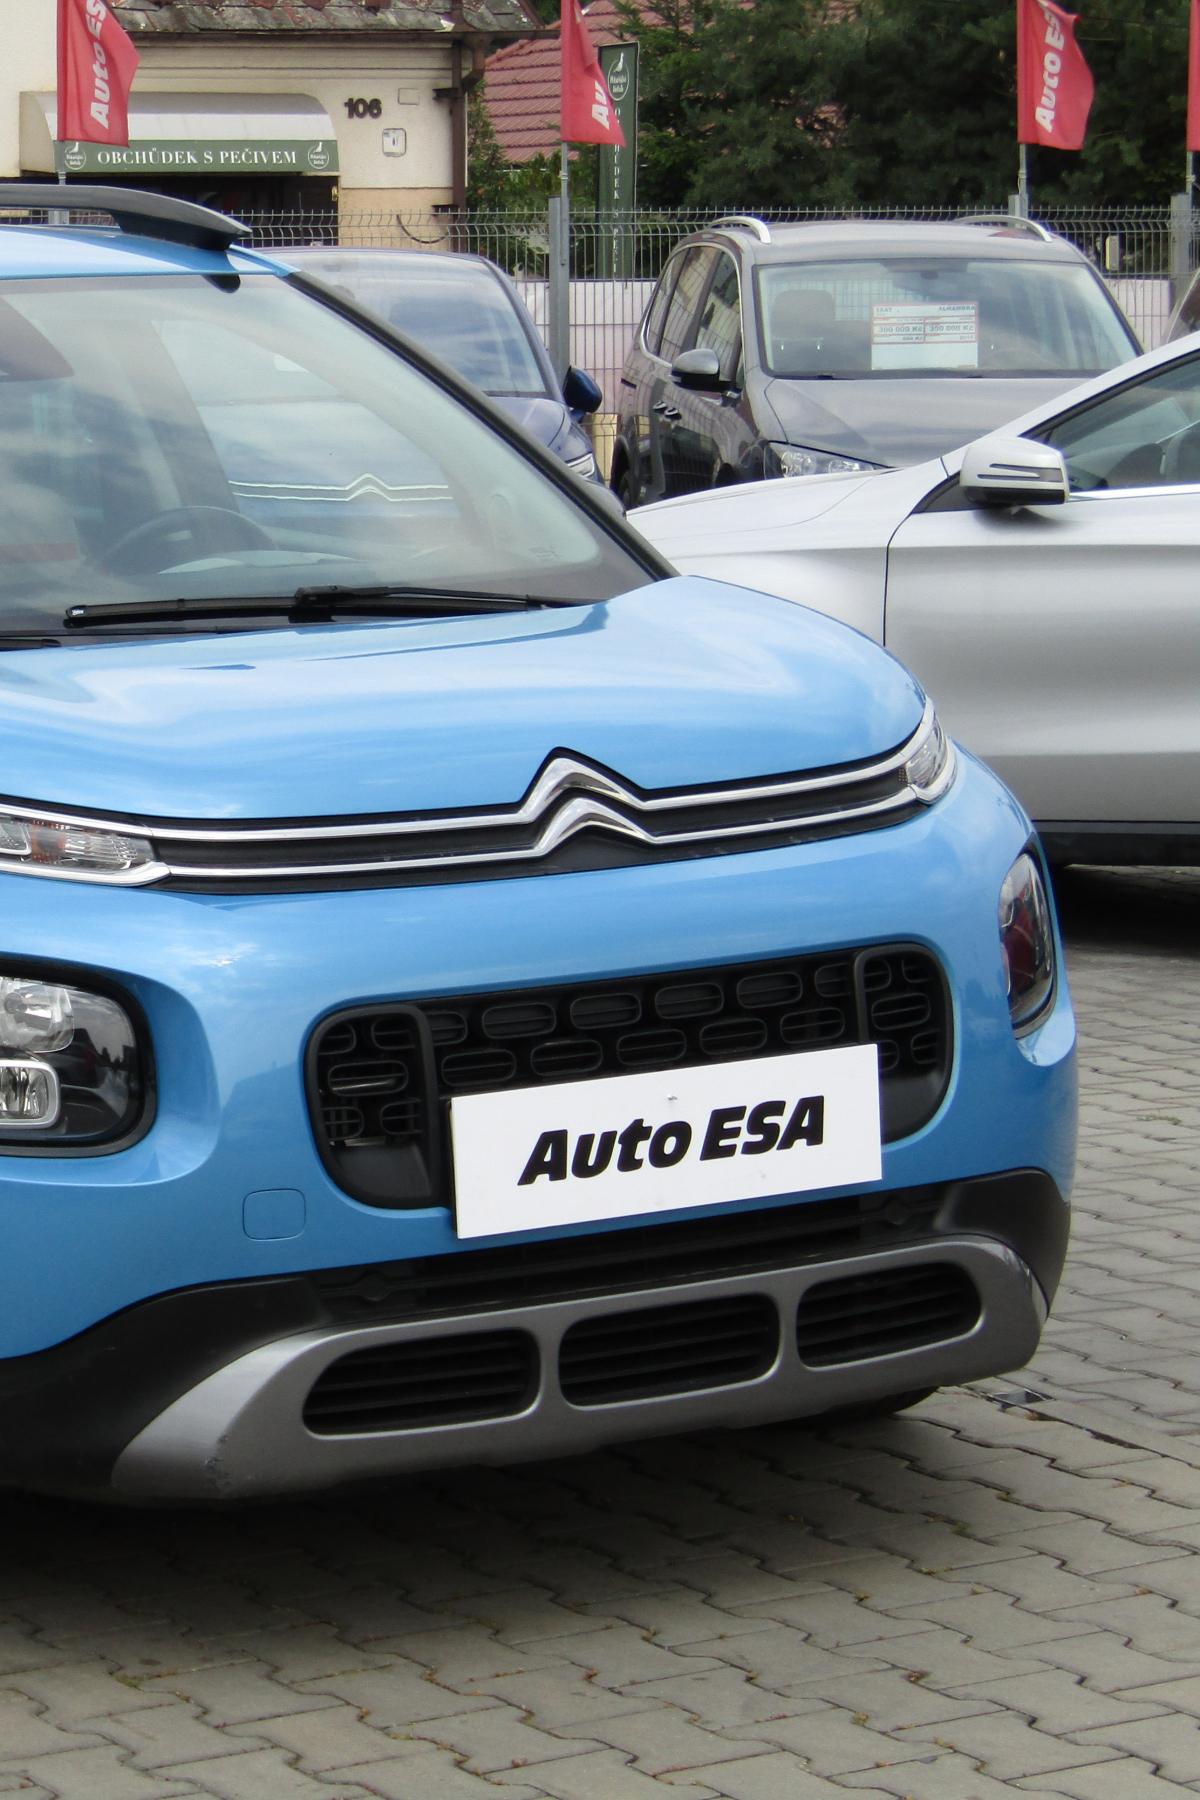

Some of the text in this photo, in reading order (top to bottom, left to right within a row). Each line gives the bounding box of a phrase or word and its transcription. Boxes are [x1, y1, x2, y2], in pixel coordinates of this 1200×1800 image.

[91, 42, 111, 129] Auto
[344, 97, 382, 119] 106
[1034, 51, 1061, 133] Auto
[203, 150, 213, 164] S
[219, 148, 296, 164] PEČIVEM
[517, 1095, 825, 1186] Auto ESA
